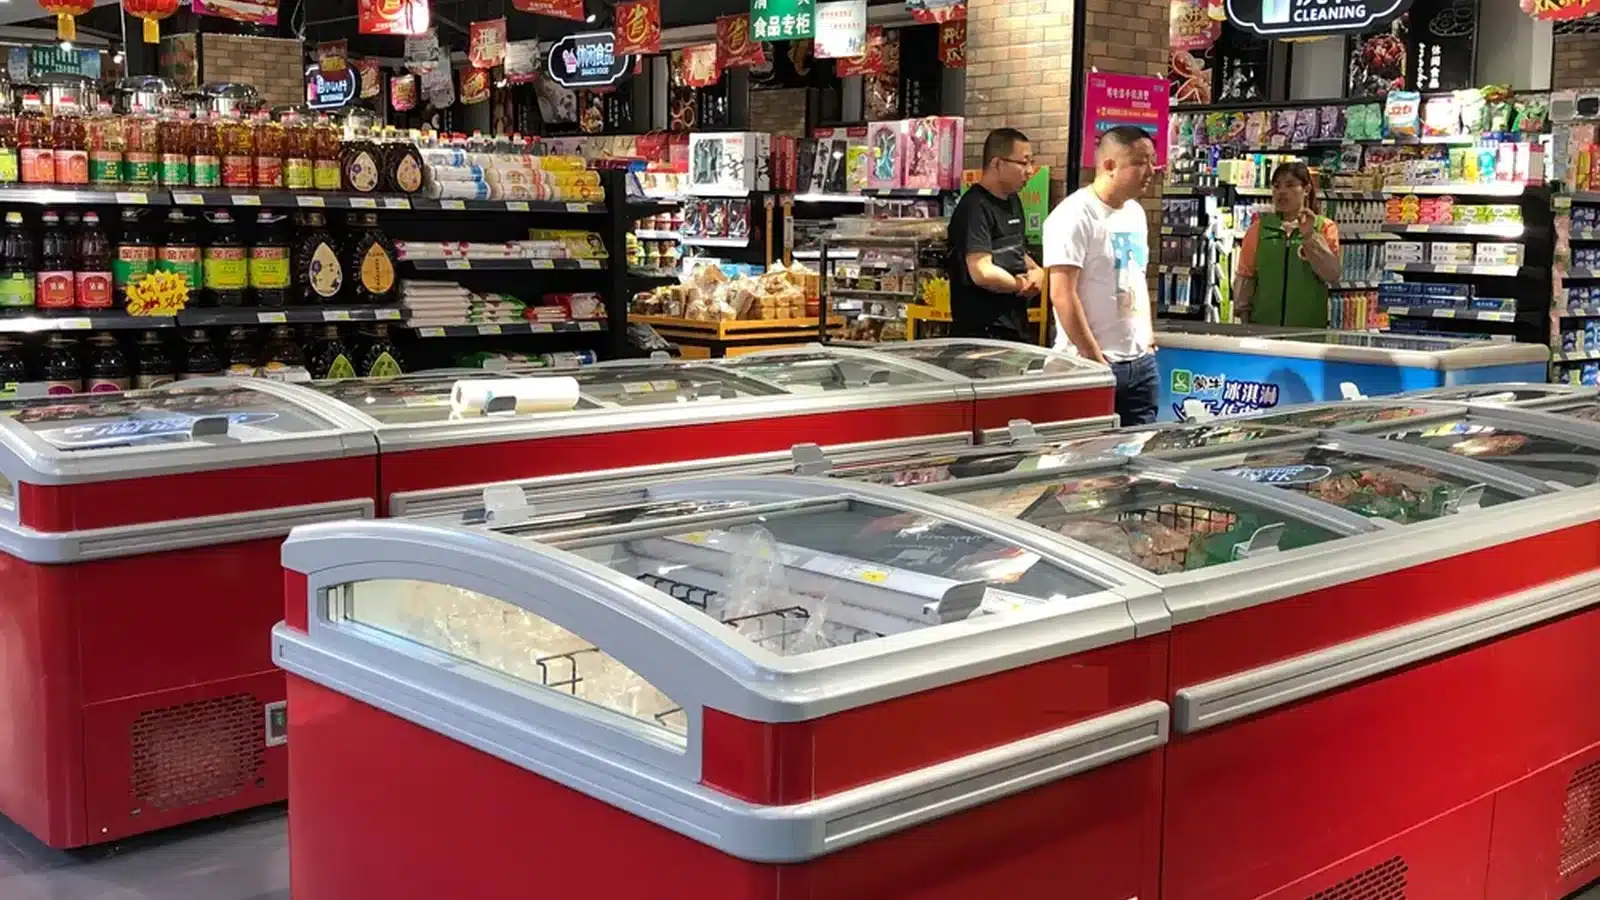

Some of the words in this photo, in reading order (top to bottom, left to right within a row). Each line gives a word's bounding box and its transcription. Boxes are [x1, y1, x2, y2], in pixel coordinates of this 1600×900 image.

[1293, 5, 1366, 22] CLEANING
[752, 13, 811, 38] 食品专柜
[1224, 382, 1277, 404] 冰淇淋
